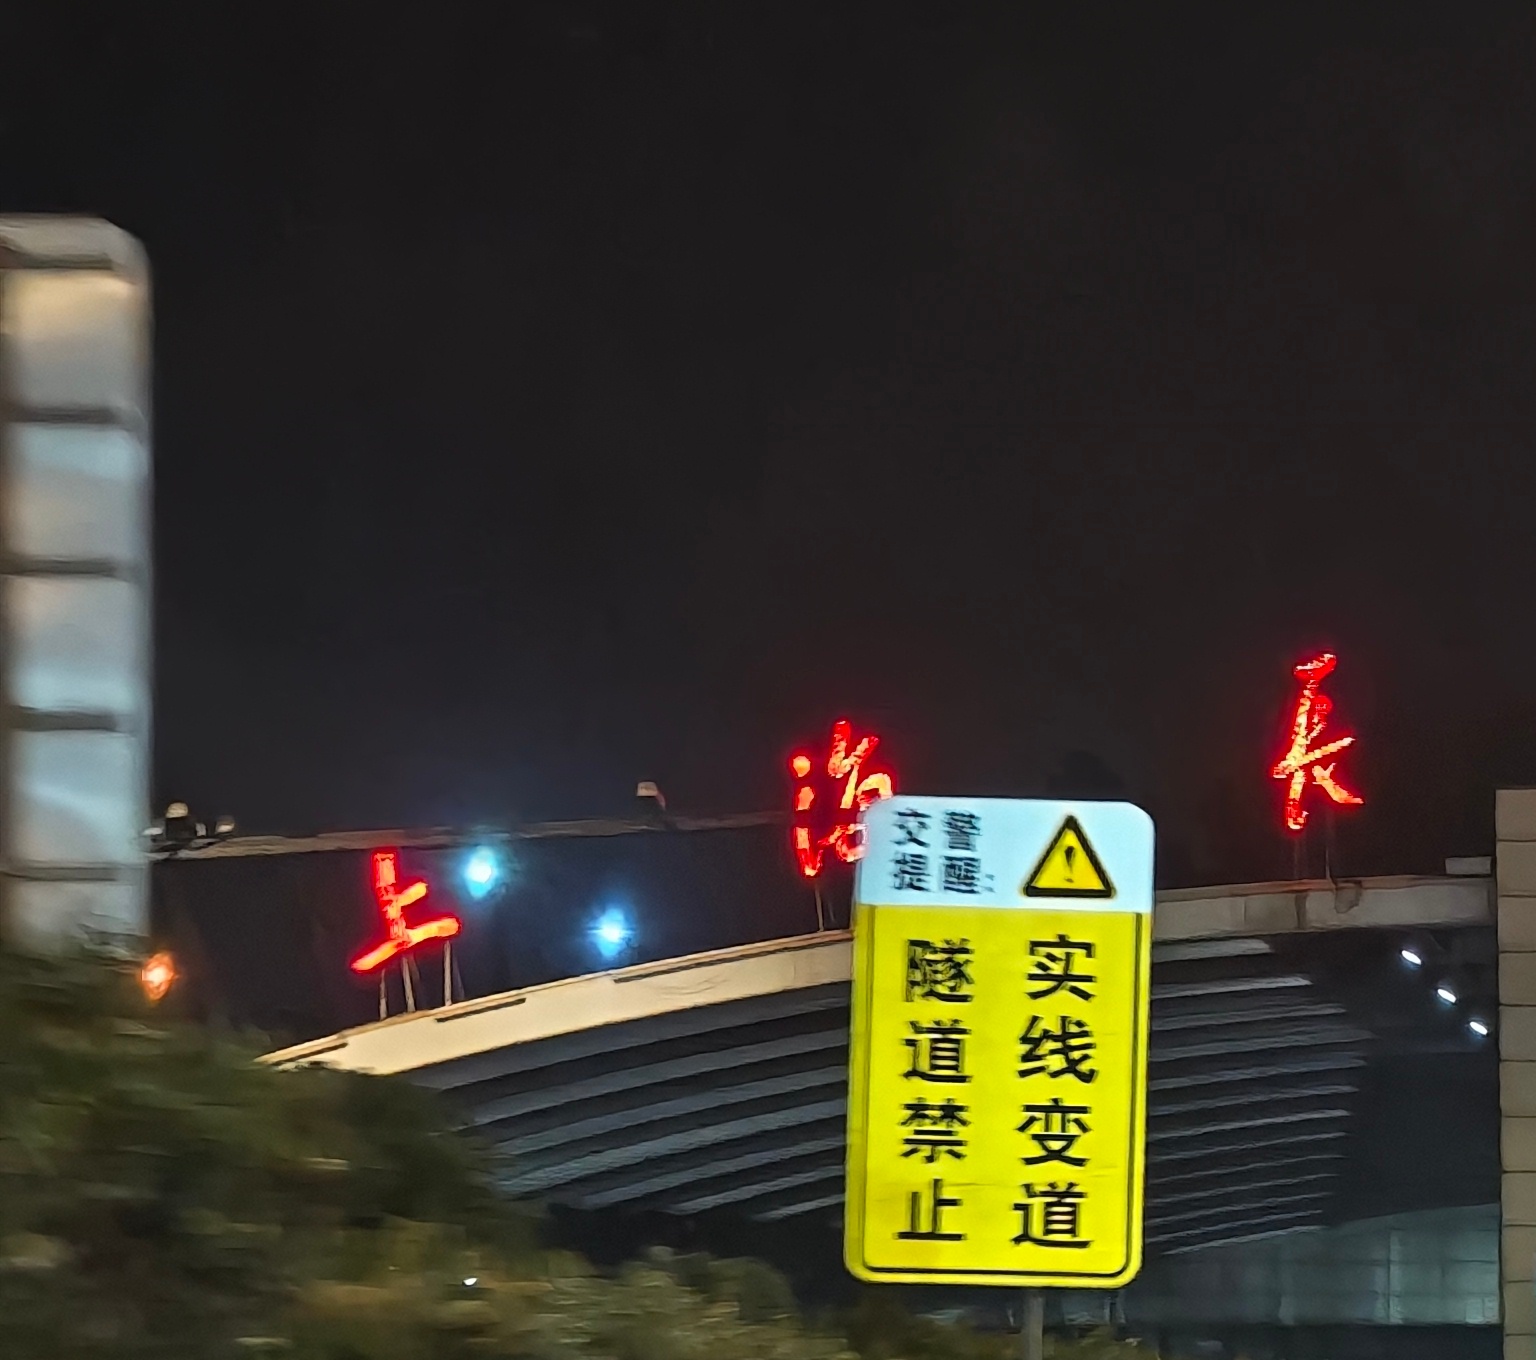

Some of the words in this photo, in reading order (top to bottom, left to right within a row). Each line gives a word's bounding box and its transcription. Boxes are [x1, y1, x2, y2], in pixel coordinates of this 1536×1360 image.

[892, 807, 982, 852] 交警
[894, 938, 975, 1242] 隧道禁止
[1011, 934, 1099, 1249] 实线变道
